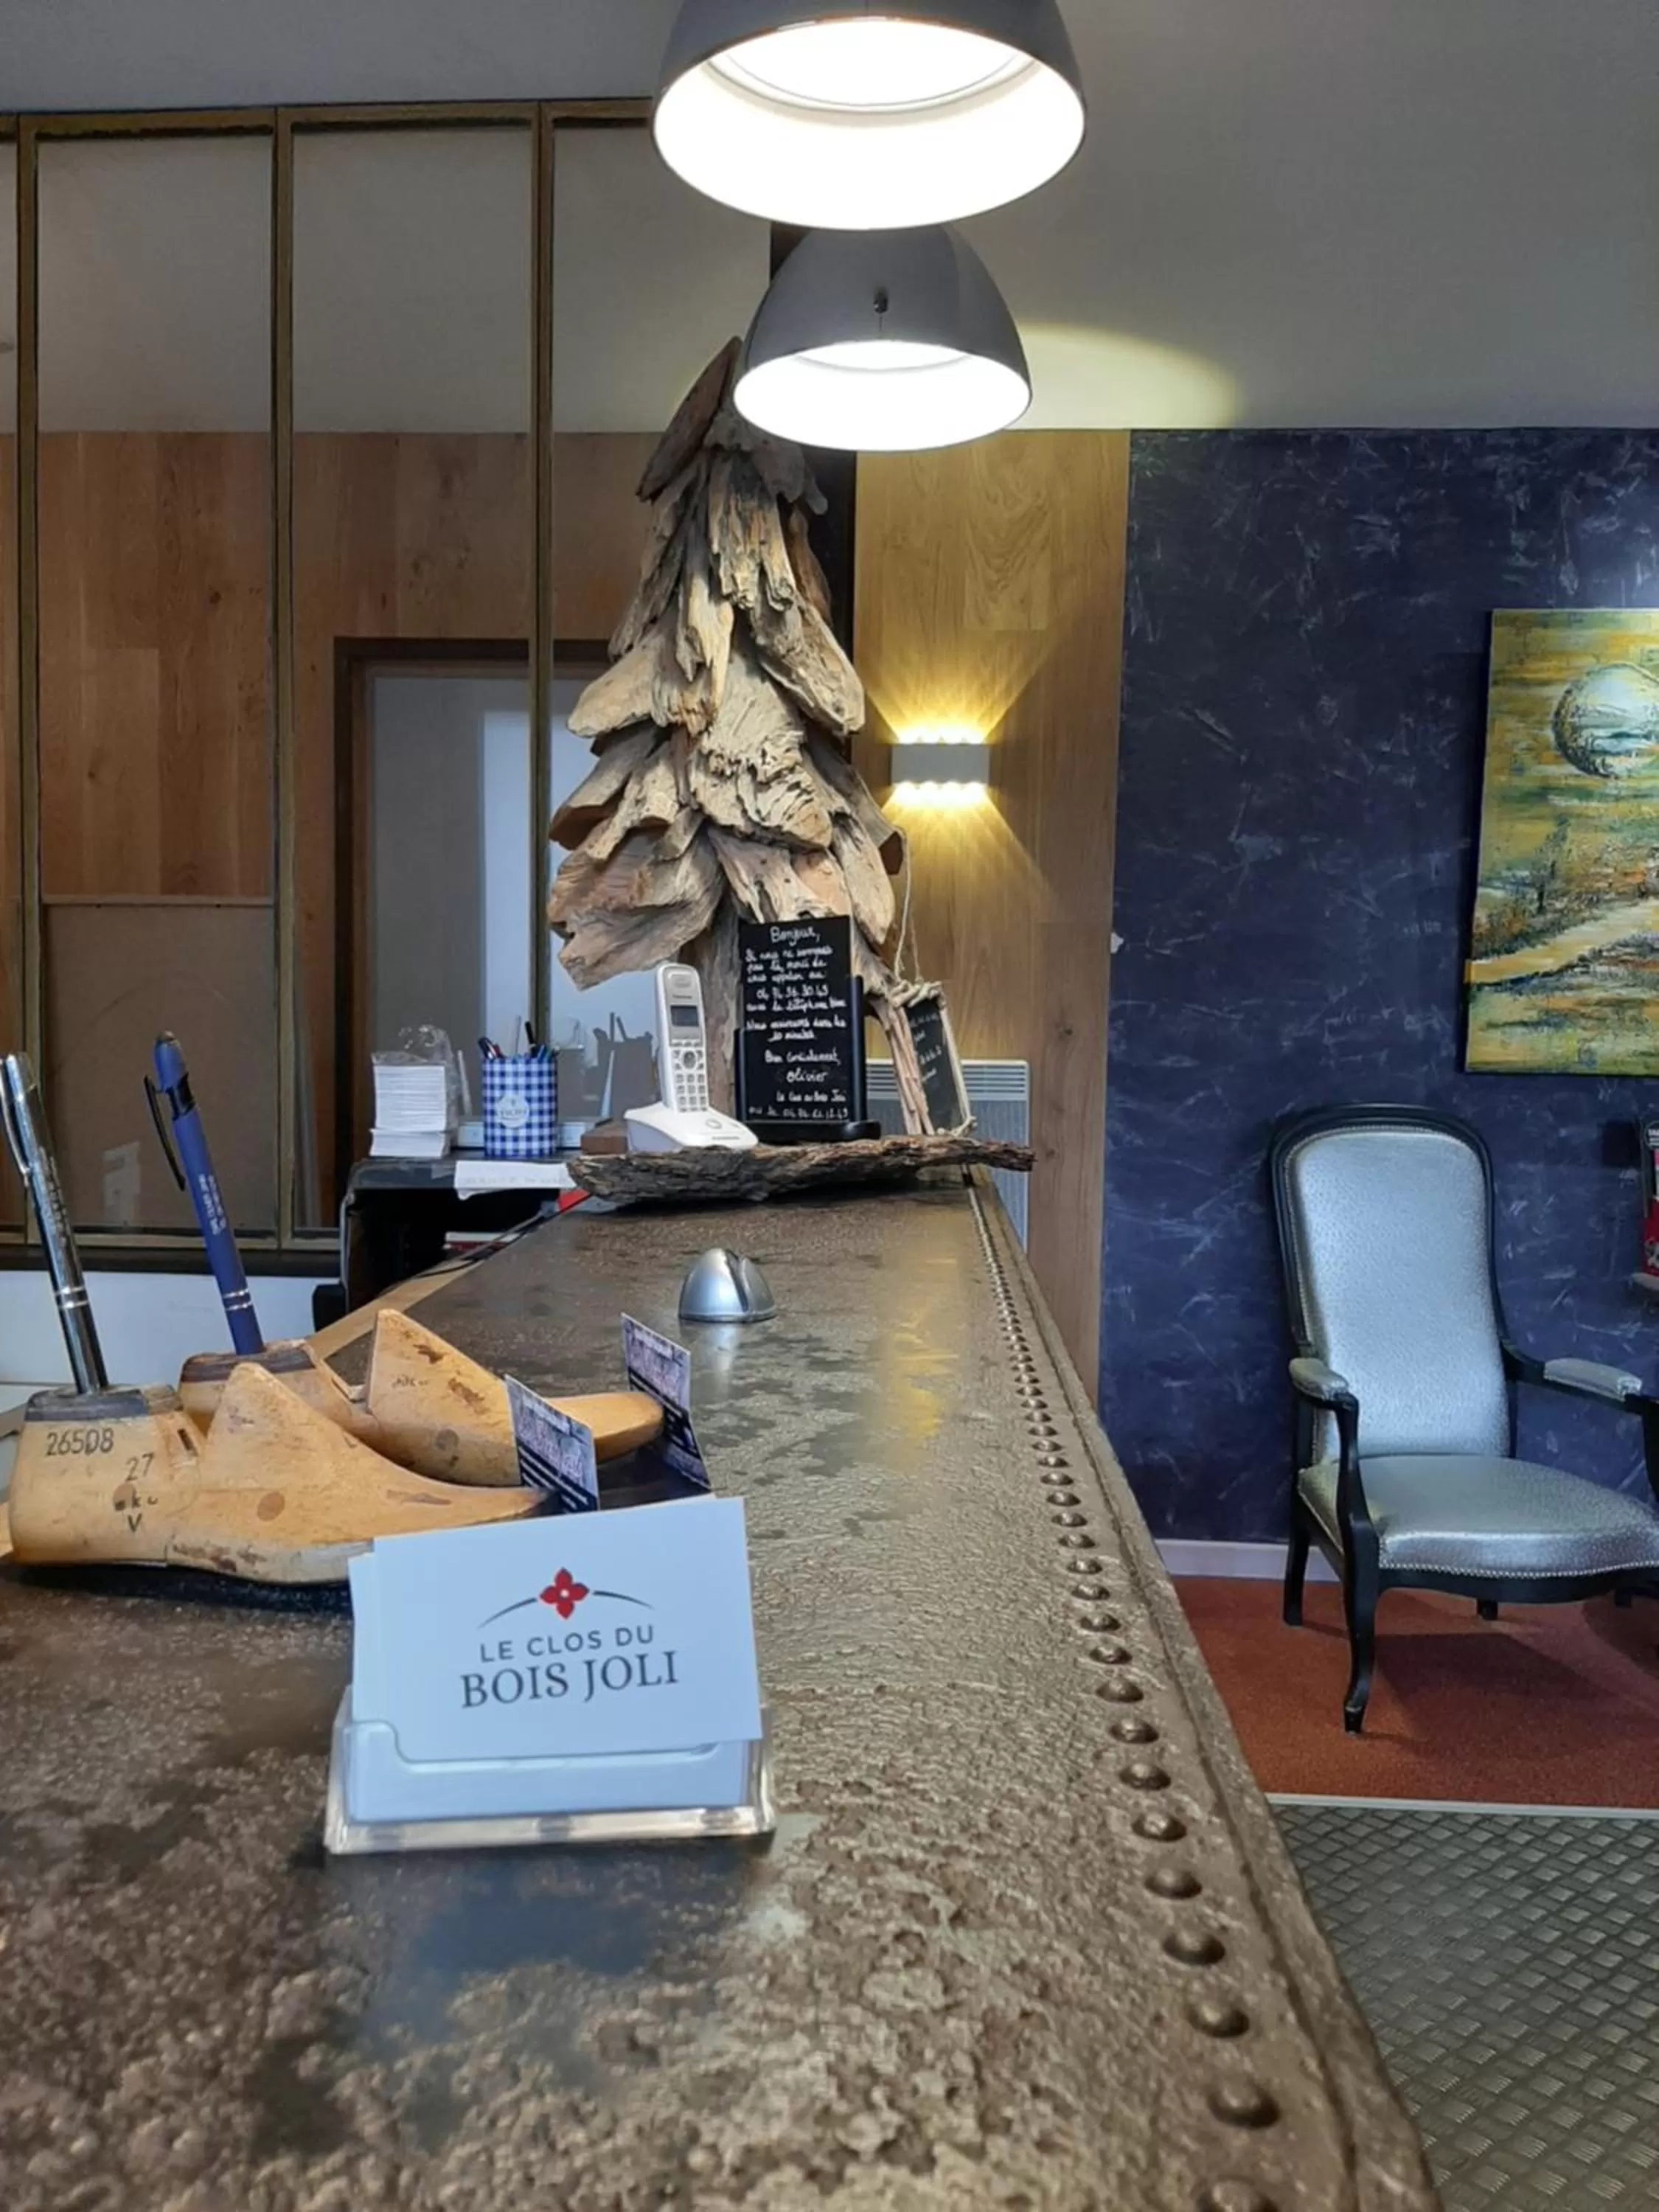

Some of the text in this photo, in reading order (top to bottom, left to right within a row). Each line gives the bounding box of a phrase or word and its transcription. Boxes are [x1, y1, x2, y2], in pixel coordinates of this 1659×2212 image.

[125, 1452, 154, 1481] 27
[480, 1624, 654, 1663] LE CLOS DU
[461, 1650, 679, 1709] BOIS JOLI
